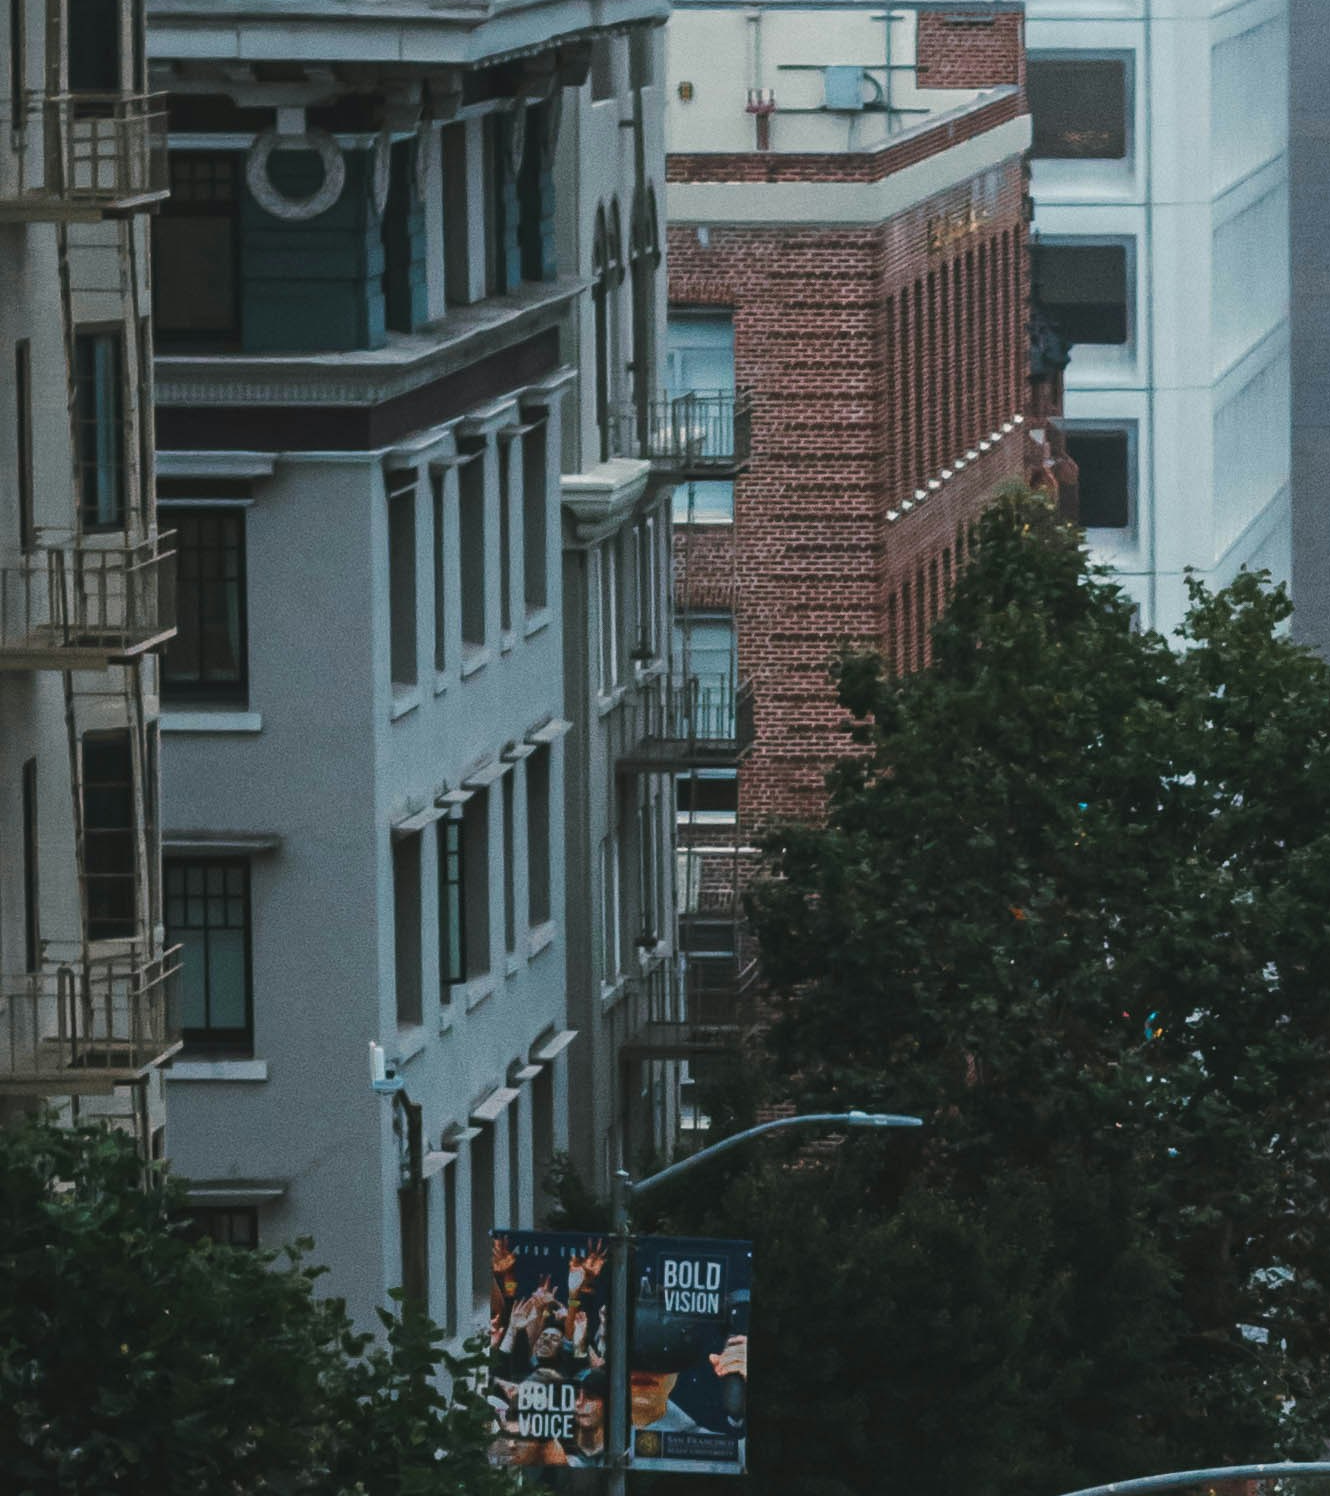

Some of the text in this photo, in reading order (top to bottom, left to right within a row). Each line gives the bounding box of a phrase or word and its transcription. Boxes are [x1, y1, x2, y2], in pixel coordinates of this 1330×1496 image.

[664, 1260, 721, 1290] BOLD
[664, 1290, 720, 1314] VISION
[518, 1383, 576, 1412] BOLD
[519, 1413, 574, 1438] VOICE
